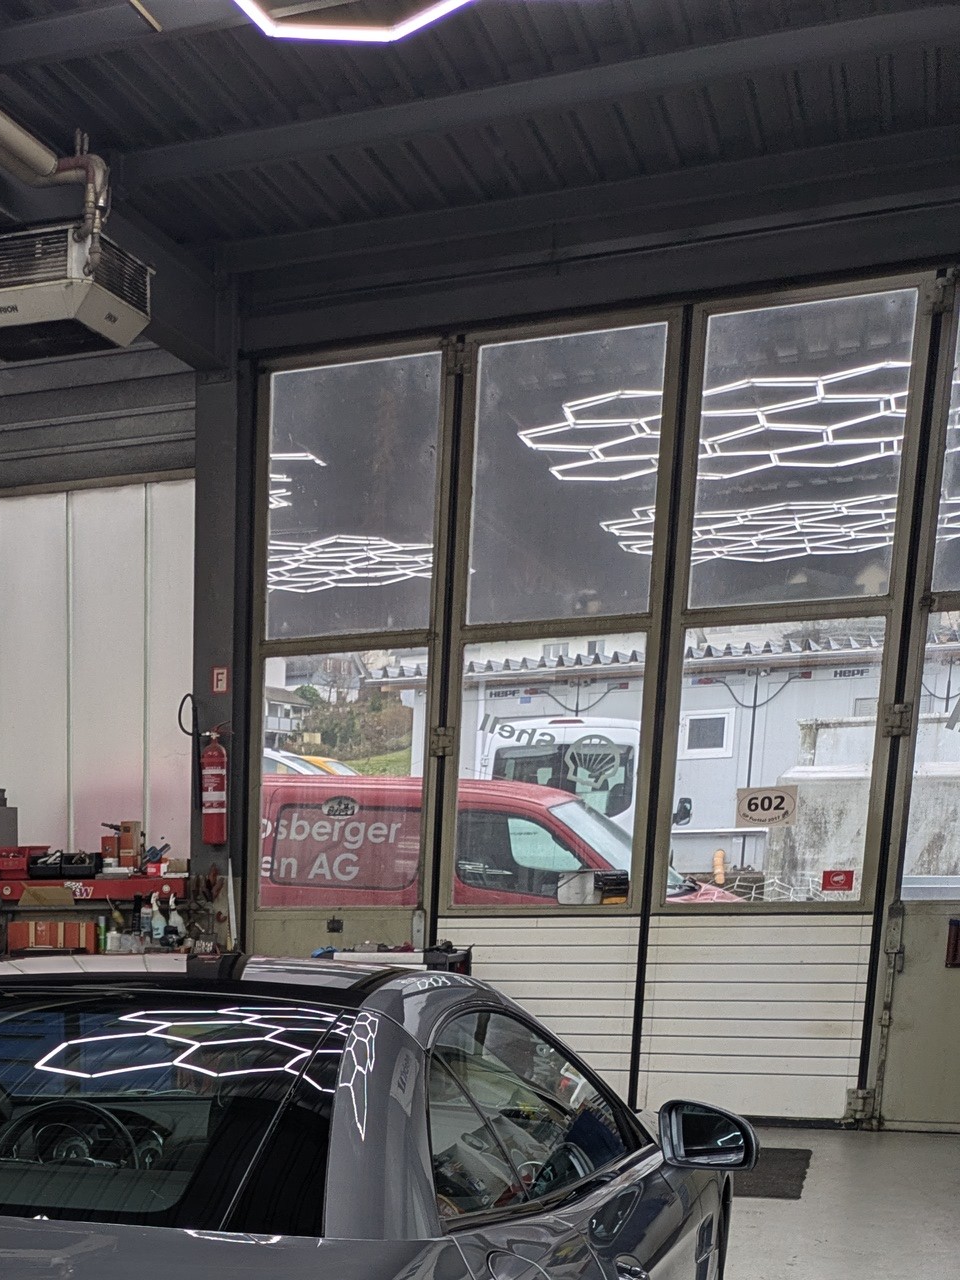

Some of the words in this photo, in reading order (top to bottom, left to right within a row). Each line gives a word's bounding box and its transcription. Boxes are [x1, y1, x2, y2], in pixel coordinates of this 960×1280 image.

[215, 671, 226, 689] F
[746, 795, 786, 812] 602
[307, 852, 360, 882] AG
